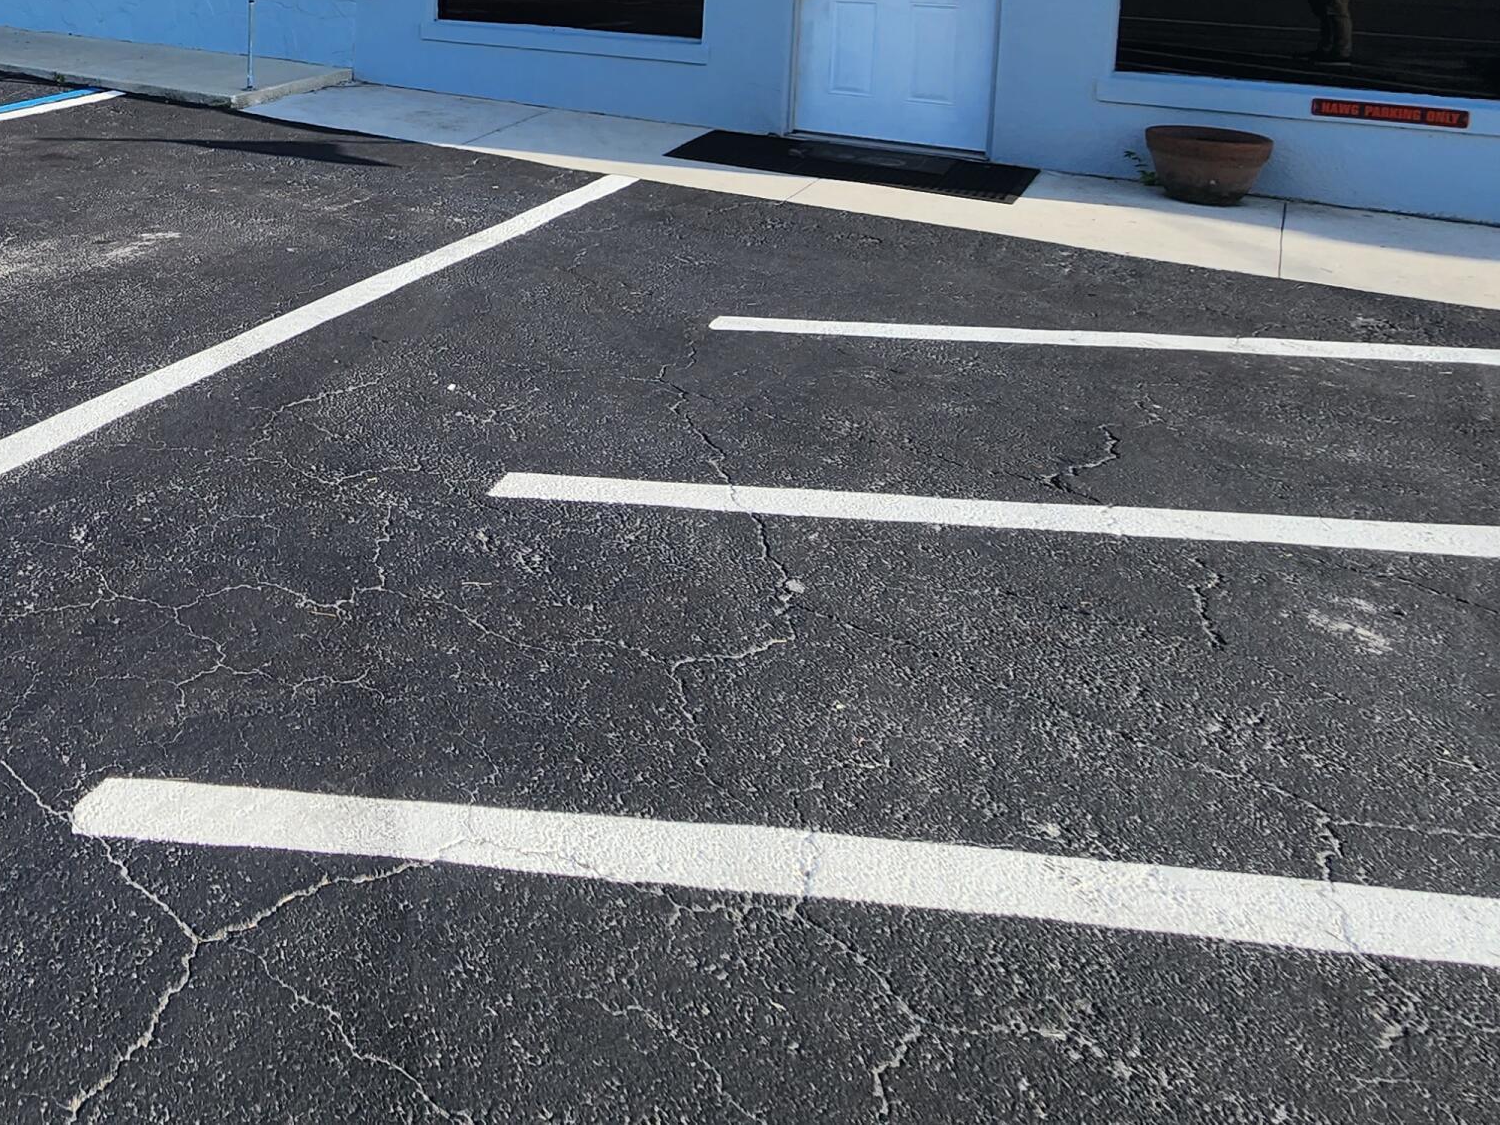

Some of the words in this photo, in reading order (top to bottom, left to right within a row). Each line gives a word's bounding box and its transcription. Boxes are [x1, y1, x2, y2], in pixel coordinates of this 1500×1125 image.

[1321, 102, 1359, 115] HAWG
[1364, 105, 1421, 121] PARKING
[1426, 111, 1461, 124] ONLY
